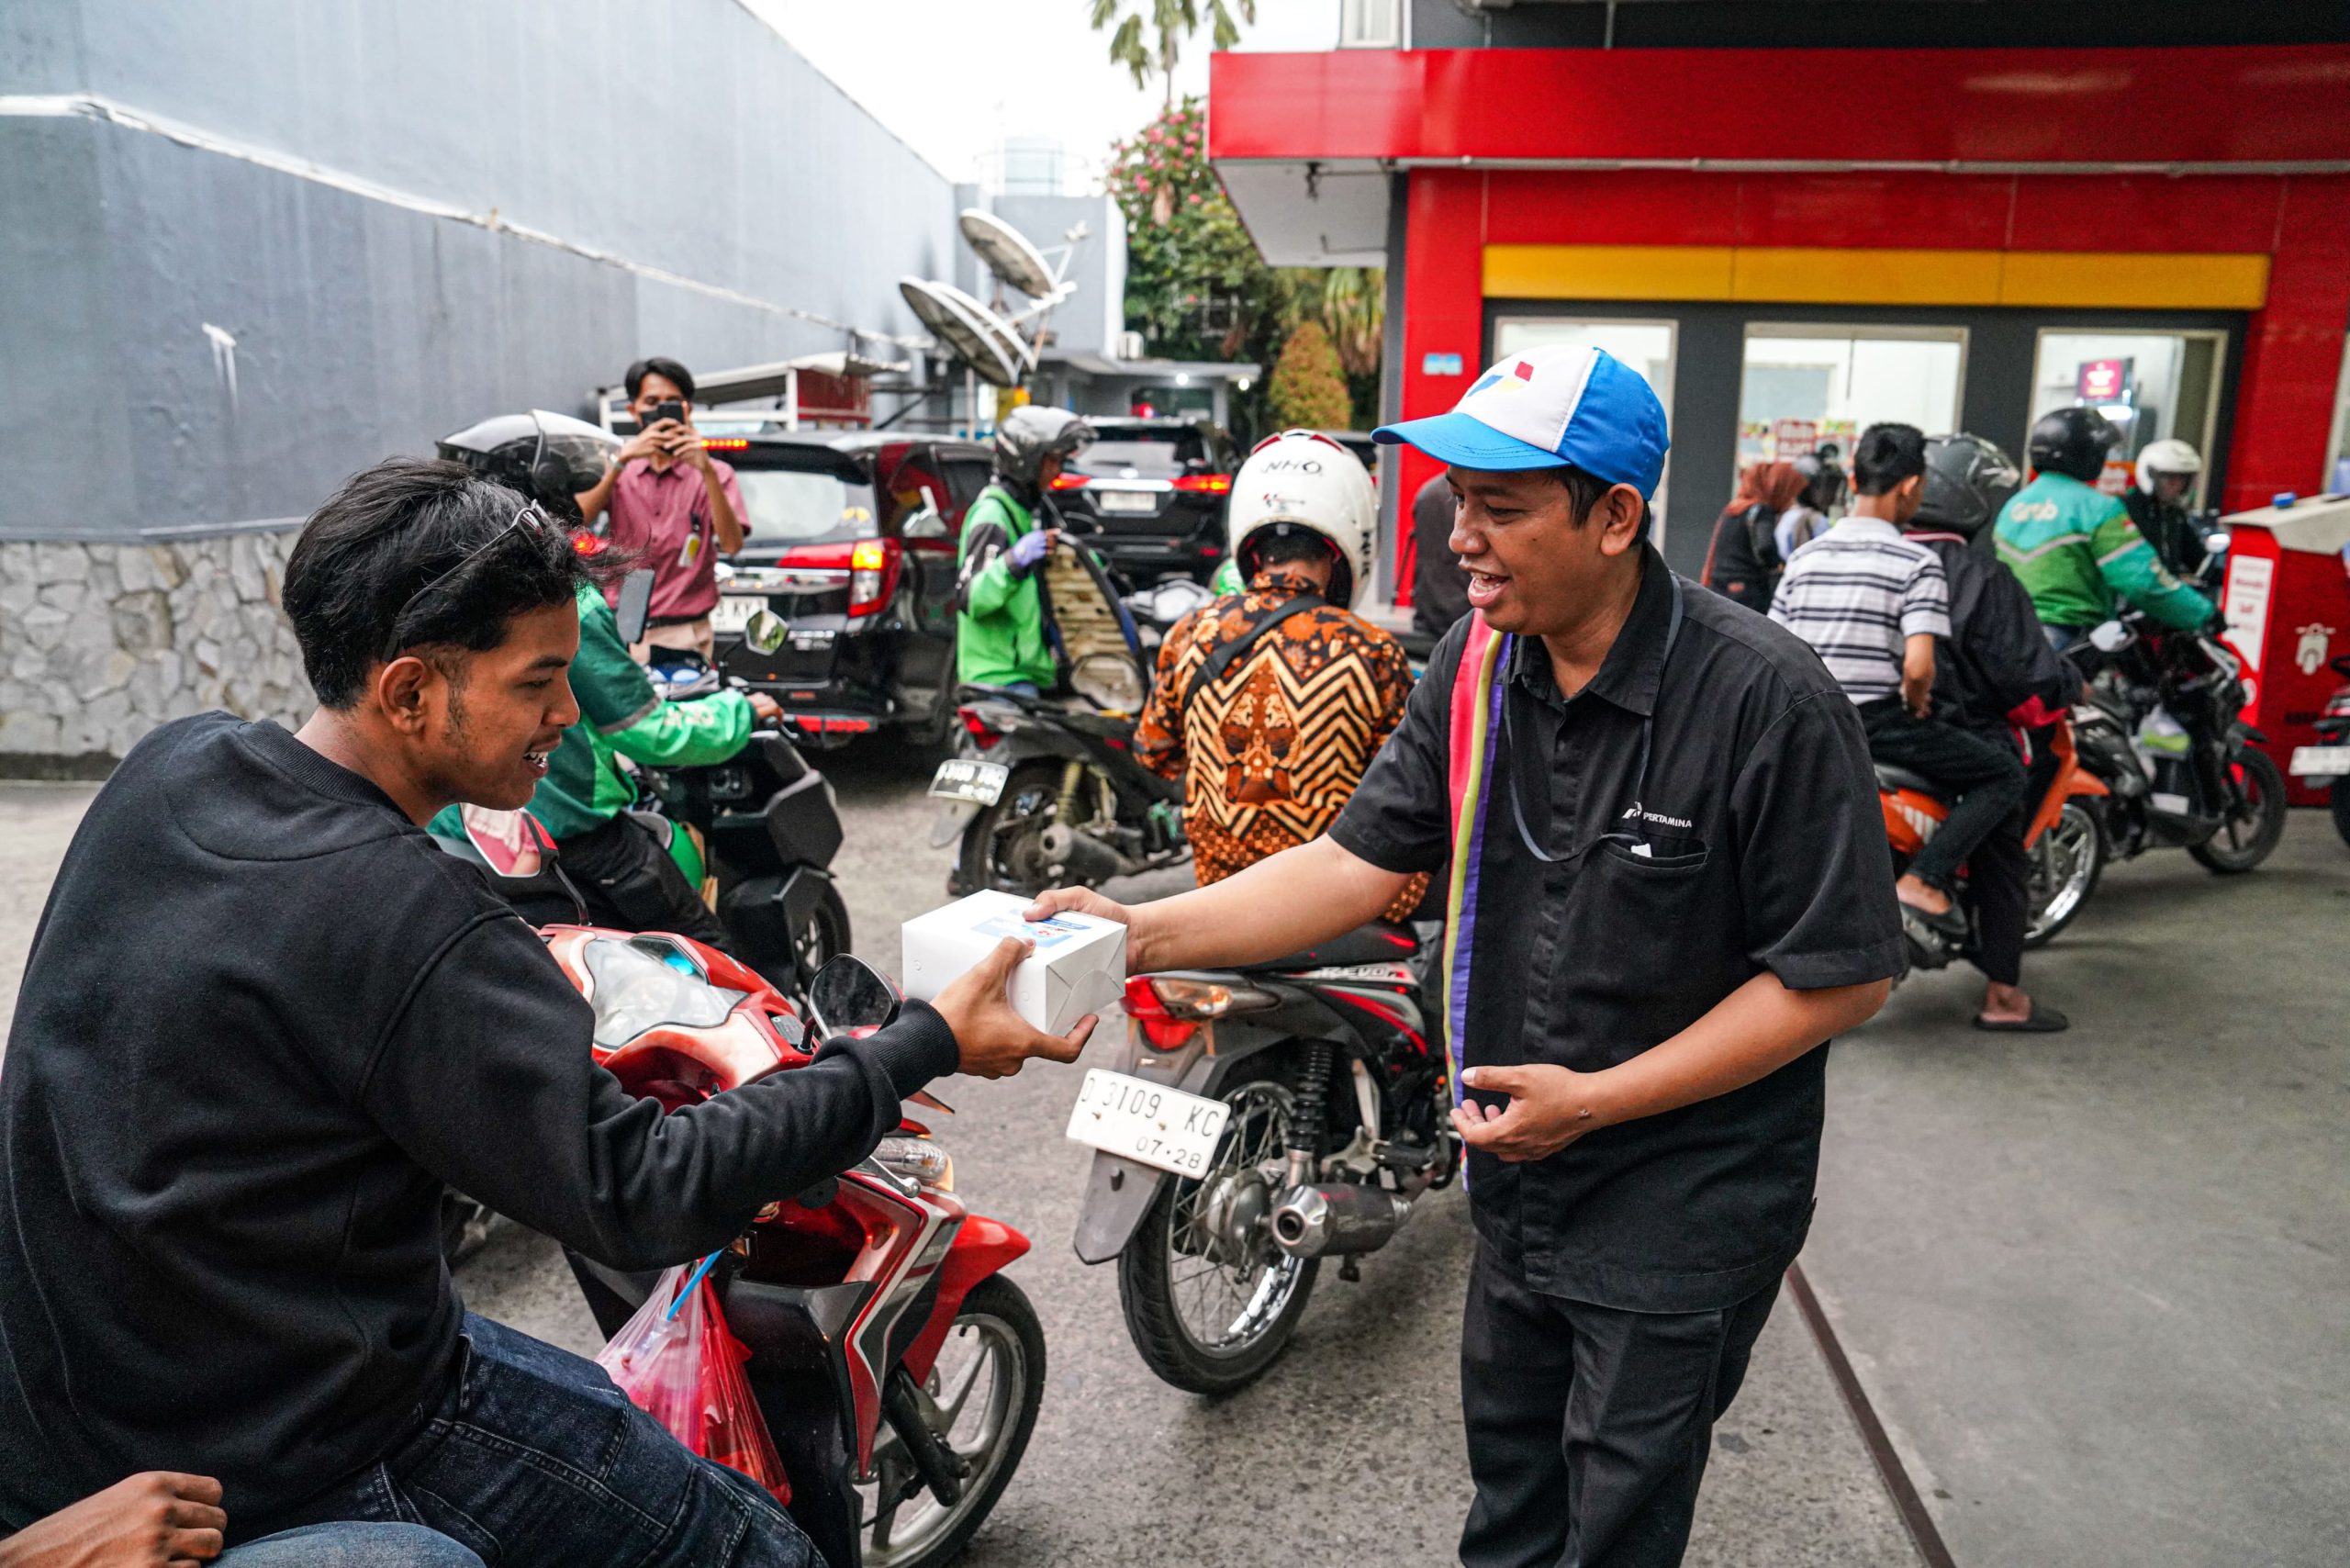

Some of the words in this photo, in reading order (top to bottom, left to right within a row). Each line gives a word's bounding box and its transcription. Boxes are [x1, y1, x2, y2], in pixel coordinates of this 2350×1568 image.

[1642, 812, 1693, 828] PERTAMINA
[1102, 1081, 1162, 1119] 3109
[1183, 1104, 1220, 1137] KC
